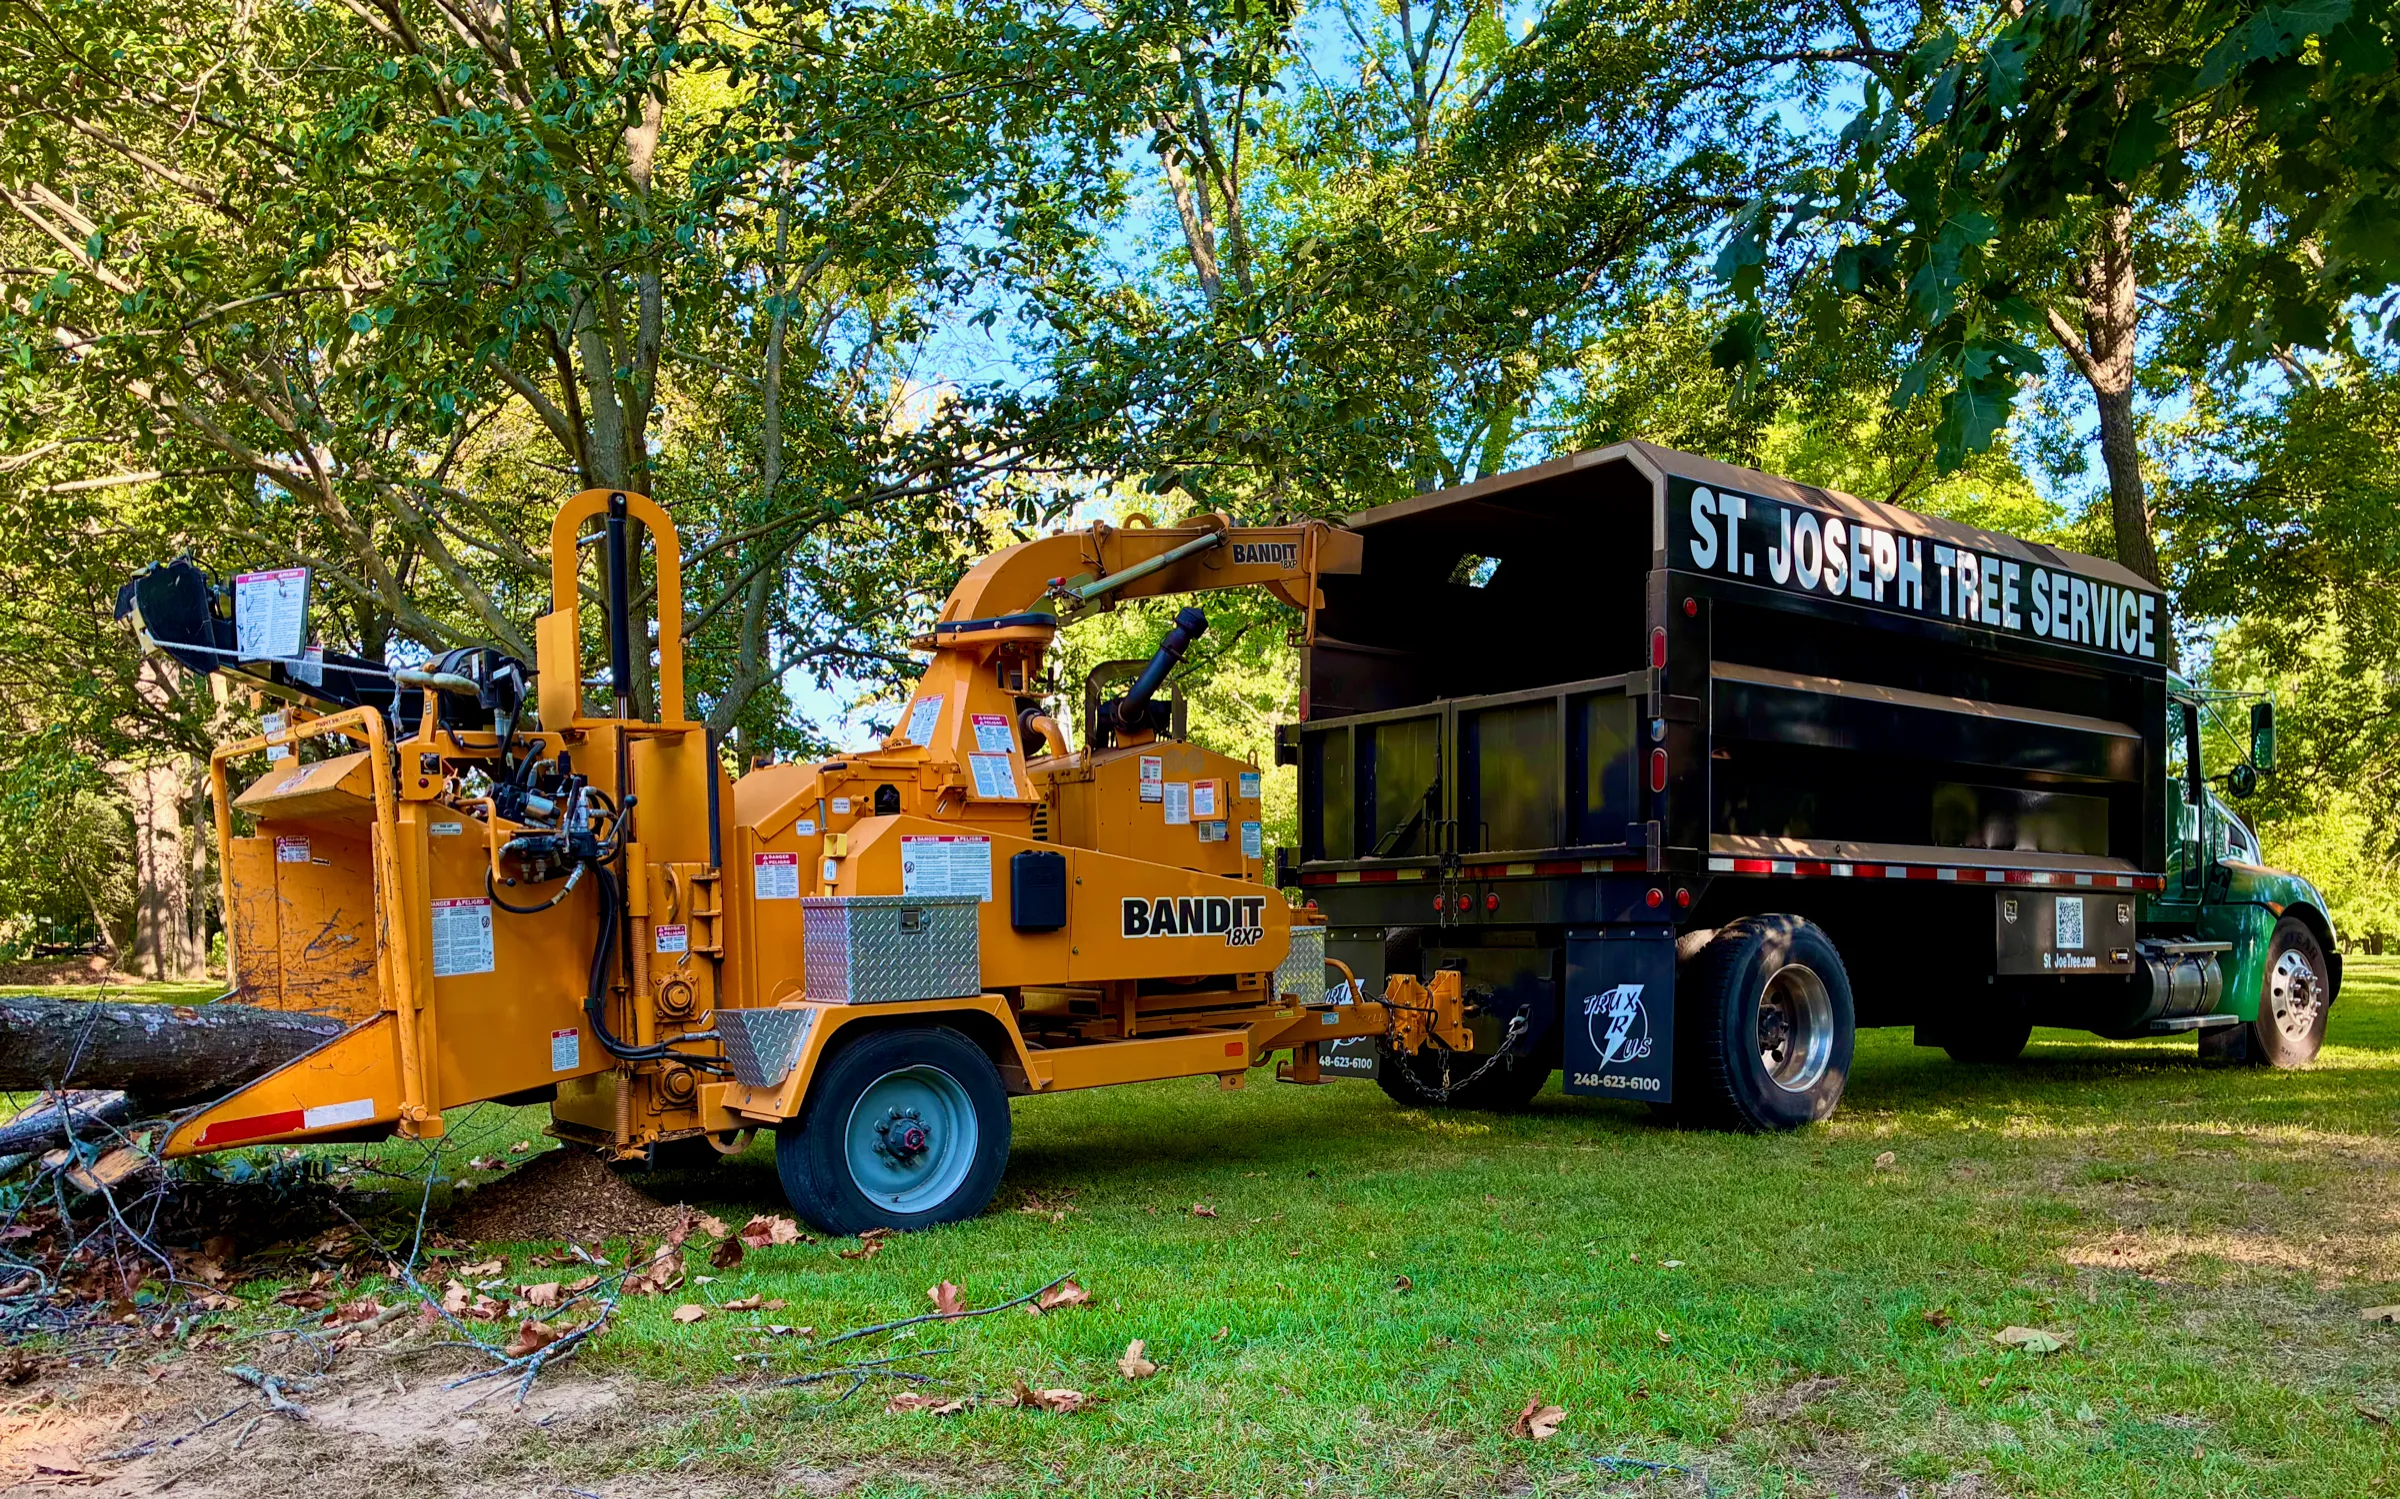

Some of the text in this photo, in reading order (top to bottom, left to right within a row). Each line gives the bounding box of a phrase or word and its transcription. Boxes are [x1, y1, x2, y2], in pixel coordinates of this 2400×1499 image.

[1232, 543, 1297, 563] BANDIT
[1280, 559, 1298, 570] 18XP
[1690, 486, 2155, 658] ST. JOSEPH TREE SERVICE
[1122, 897, 1265, 937] BANDIT
[1225, 927, 1264, 946] 18XP
[2055, 952, 2097, 968] JoeTree.com
[1583, 991, 1639, 1015] TRUX
[1611, 1015, 1629, 1033] R
[1622, 1037, 1653, 1058] US
[1319, 1055, 1373, 1069] 48-623-6100
[1573, 1072, 1661, 1091] 248-623-6100
